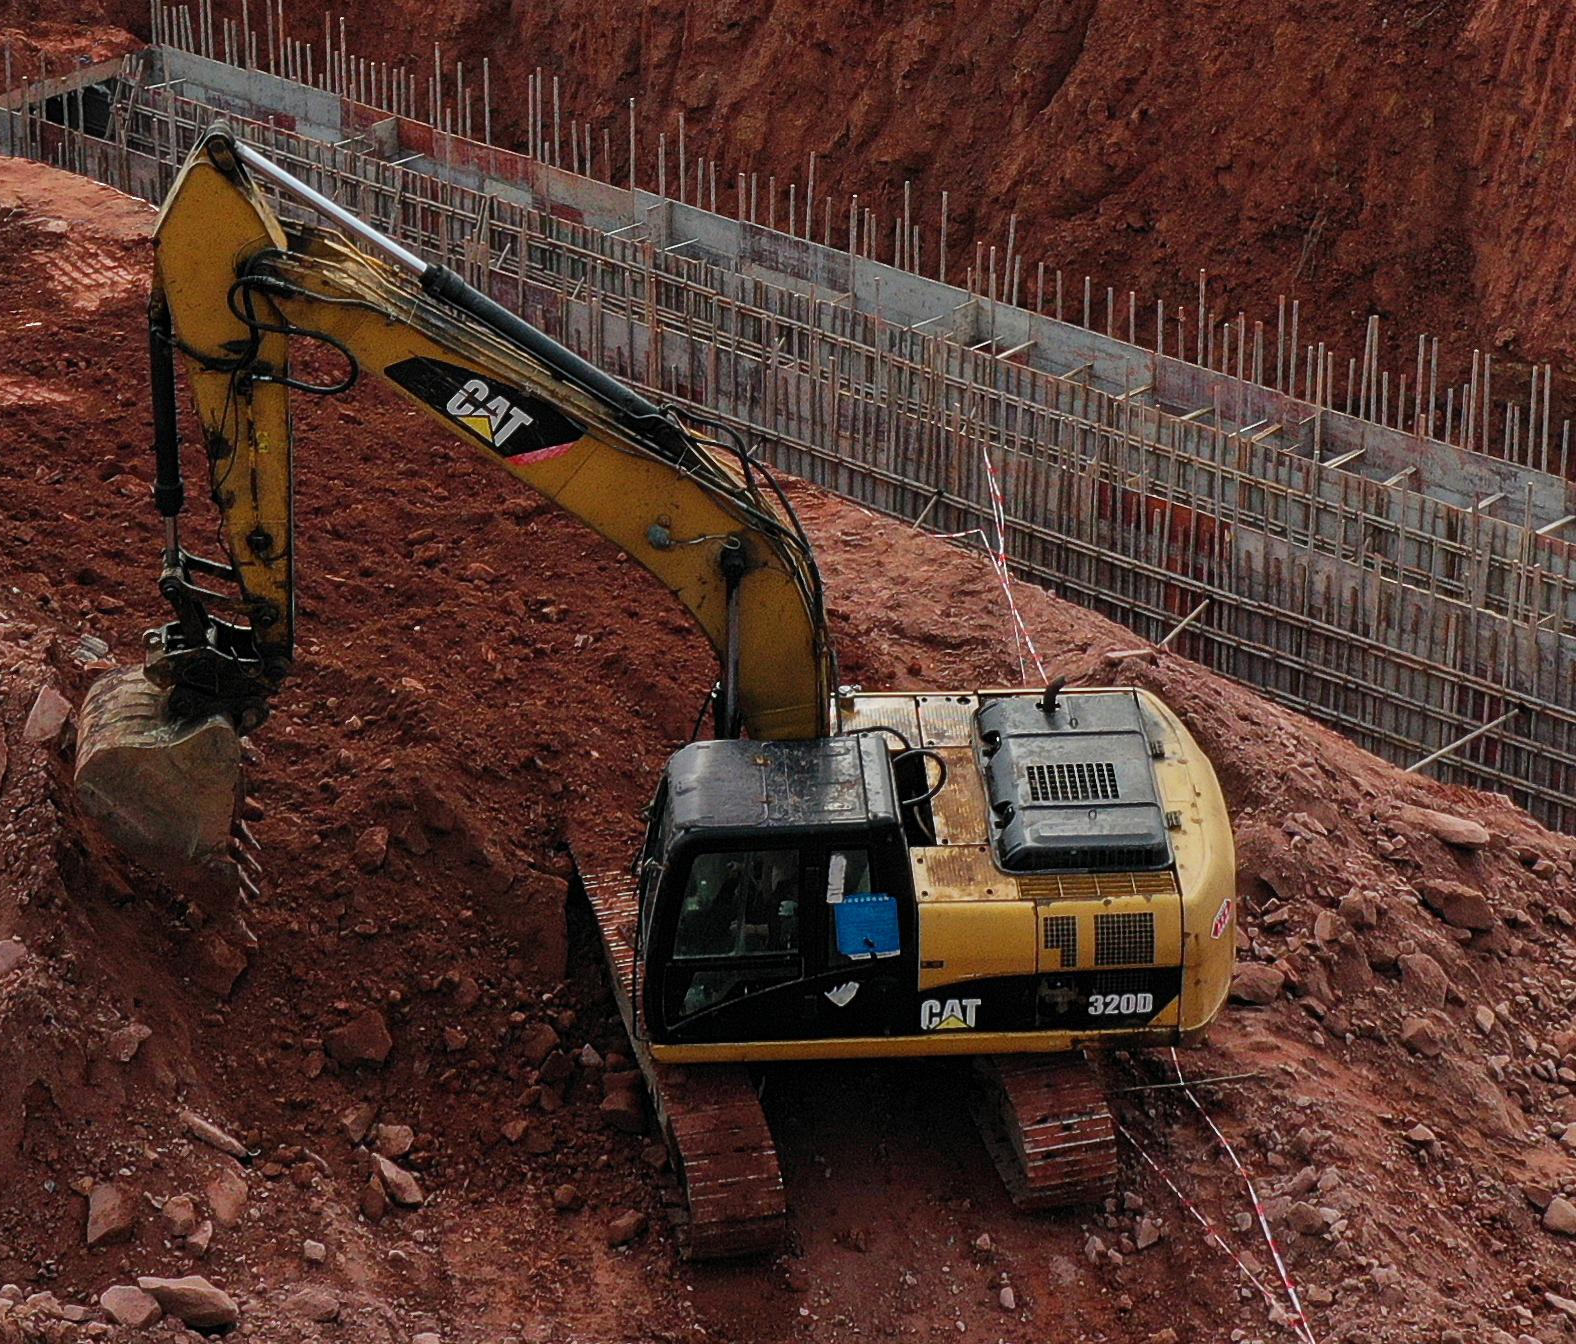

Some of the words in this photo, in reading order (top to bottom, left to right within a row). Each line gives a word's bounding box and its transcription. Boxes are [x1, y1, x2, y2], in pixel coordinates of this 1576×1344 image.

[446, 379, 534, 447] CAT
[920, 999, 981, 1030] CAT
[1088, 993, 1153, 1014] 320D
